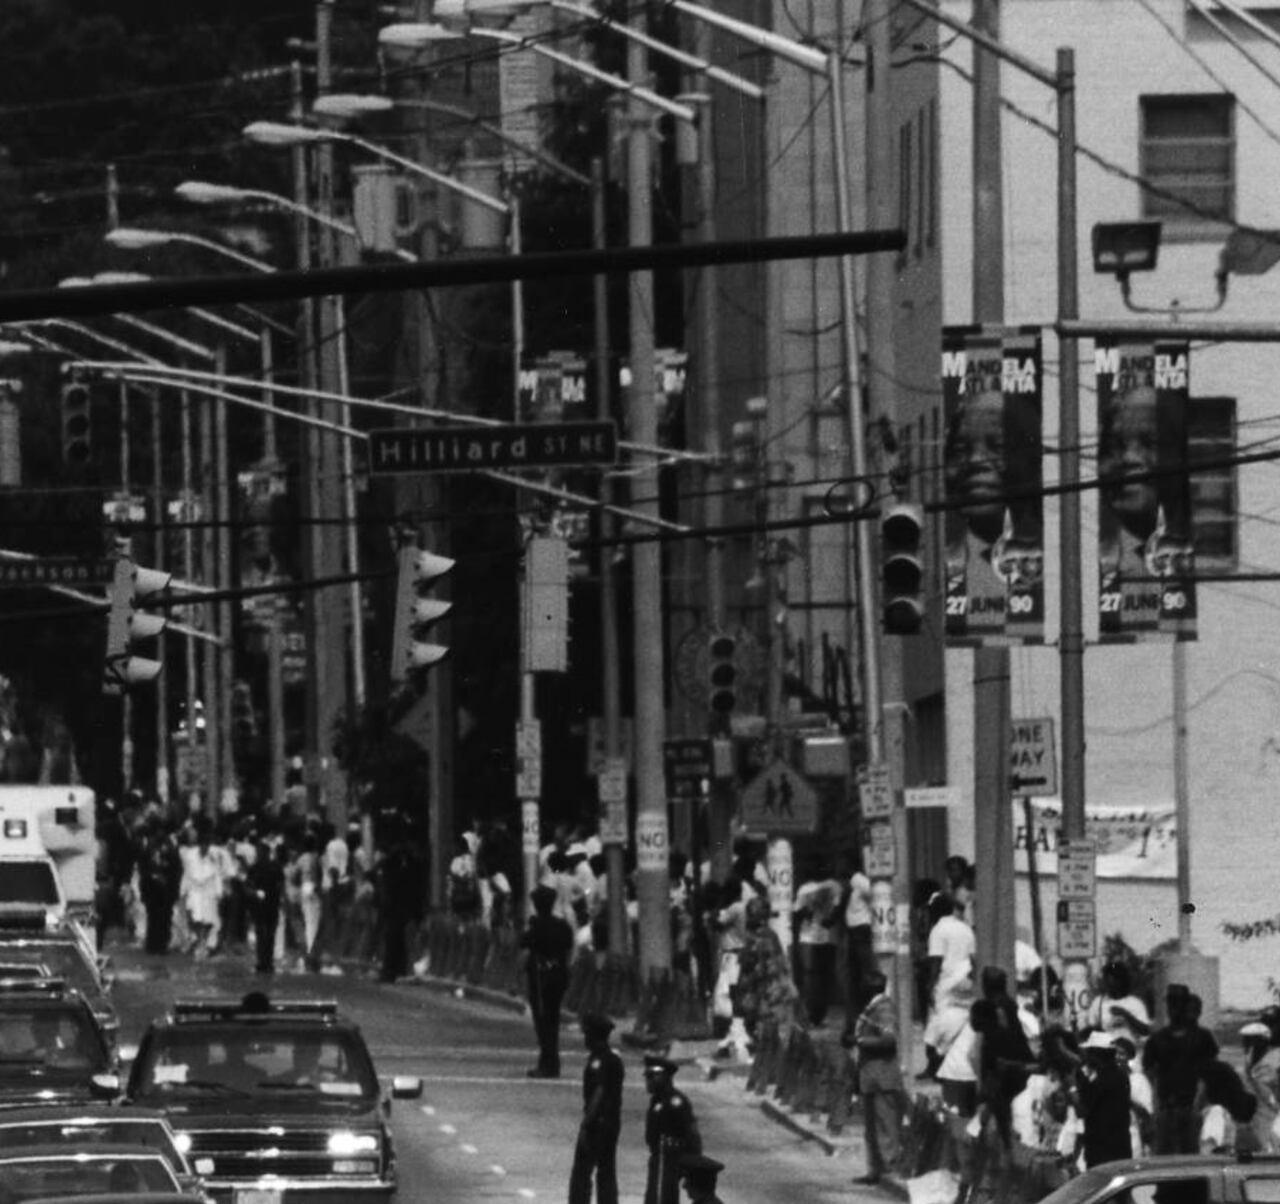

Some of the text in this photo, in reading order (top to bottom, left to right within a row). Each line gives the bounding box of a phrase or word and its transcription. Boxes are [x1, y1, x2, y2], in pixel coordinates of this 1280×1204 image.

[941, 350, 1036, 378] MANDELA
[1095, 346, 1187, 375] MANDELA
[958, 373, 1036, 394] ATLANTA
[380, 436, 526, 463] Hilliard
[544, 434, 566, 455] ST
[946, 596, 967, 615] 27
[1009, 595, 1033, 614] 90
[1100, 593, 1121, 612] 27
[1163, 591, 1186, 611] 90
[640, 833, 665, 848] NO
[872, 907, 896, 926] NO
